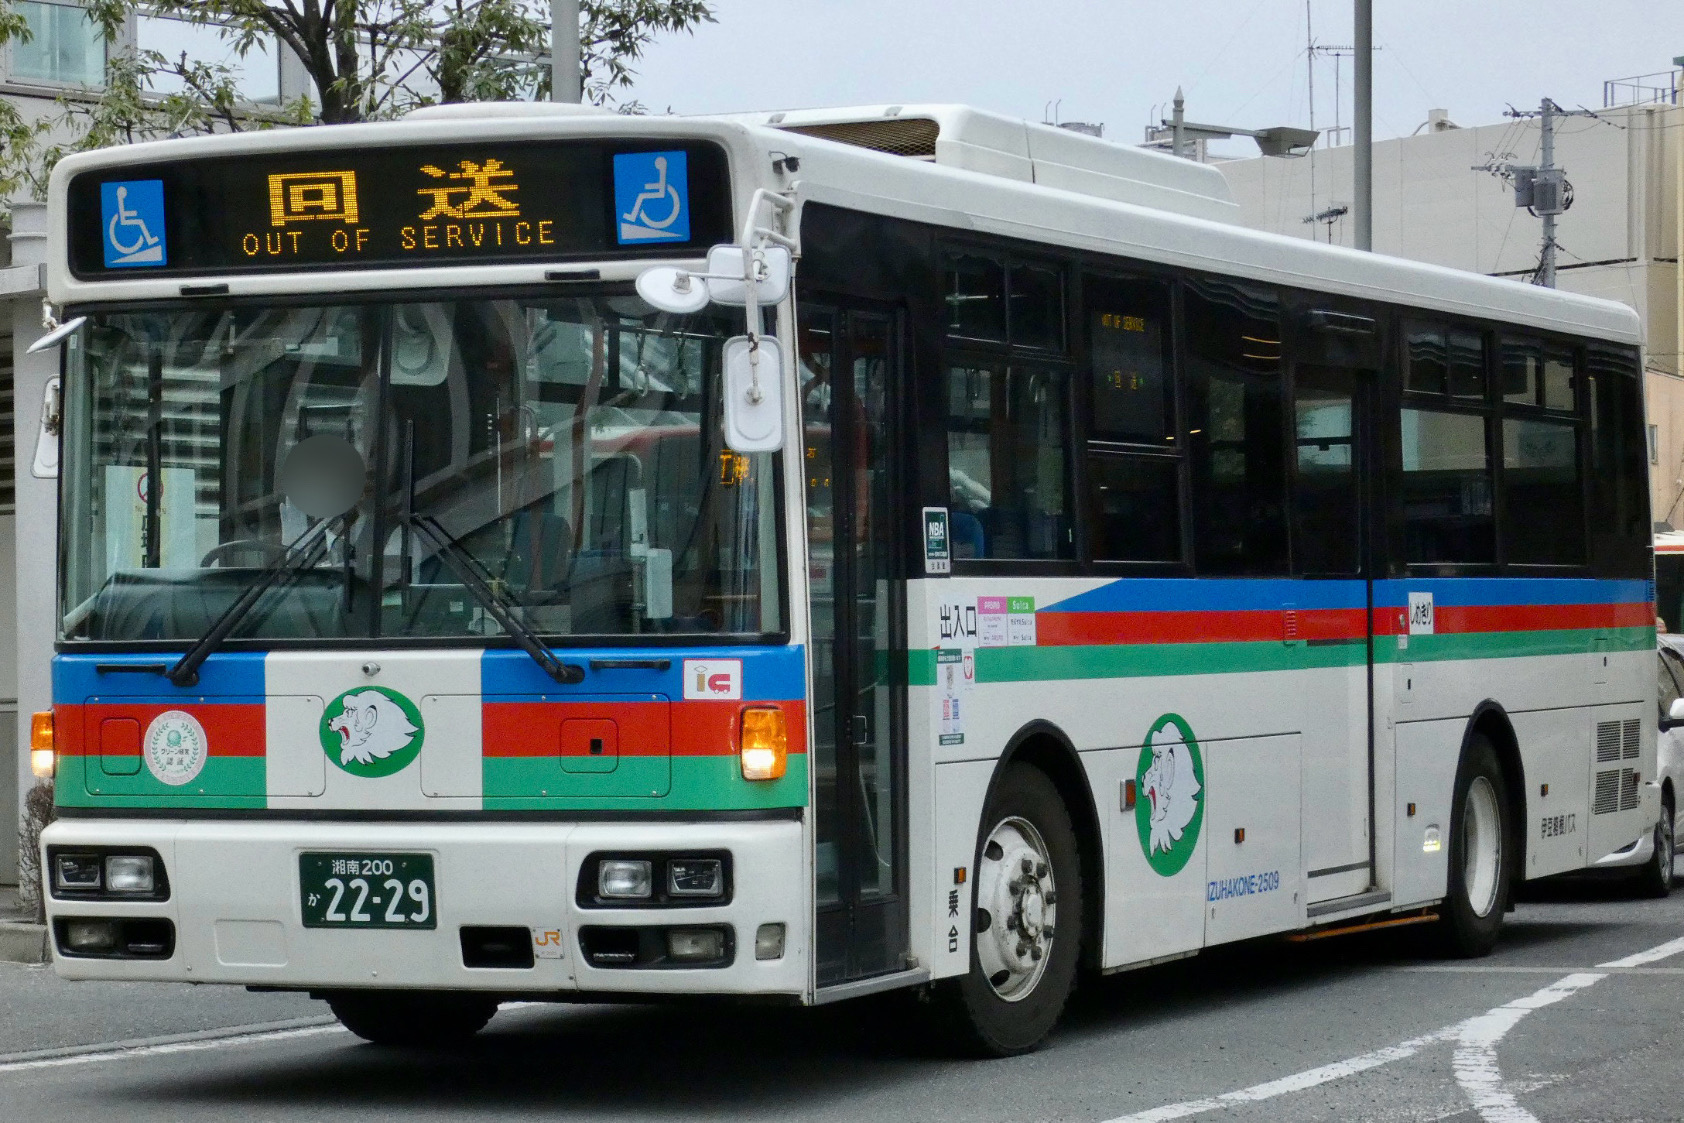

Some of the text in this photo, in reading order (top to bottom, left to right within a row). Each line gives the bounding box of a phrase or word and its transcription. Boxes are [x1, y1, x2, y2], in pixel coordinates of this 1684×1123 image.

[268, 158, 520, 226] 回送
[243, 220, 554, 255] OUT OF SERVICE
[929, 521, 944, 537] NBA
[940, 604, 977, 640] 出入口
[308, 877, 430, 923] か 22-29
[1207, 870, 1280, 902] IZUHAKONE-2509
[535, 931, 561, 947] JR
